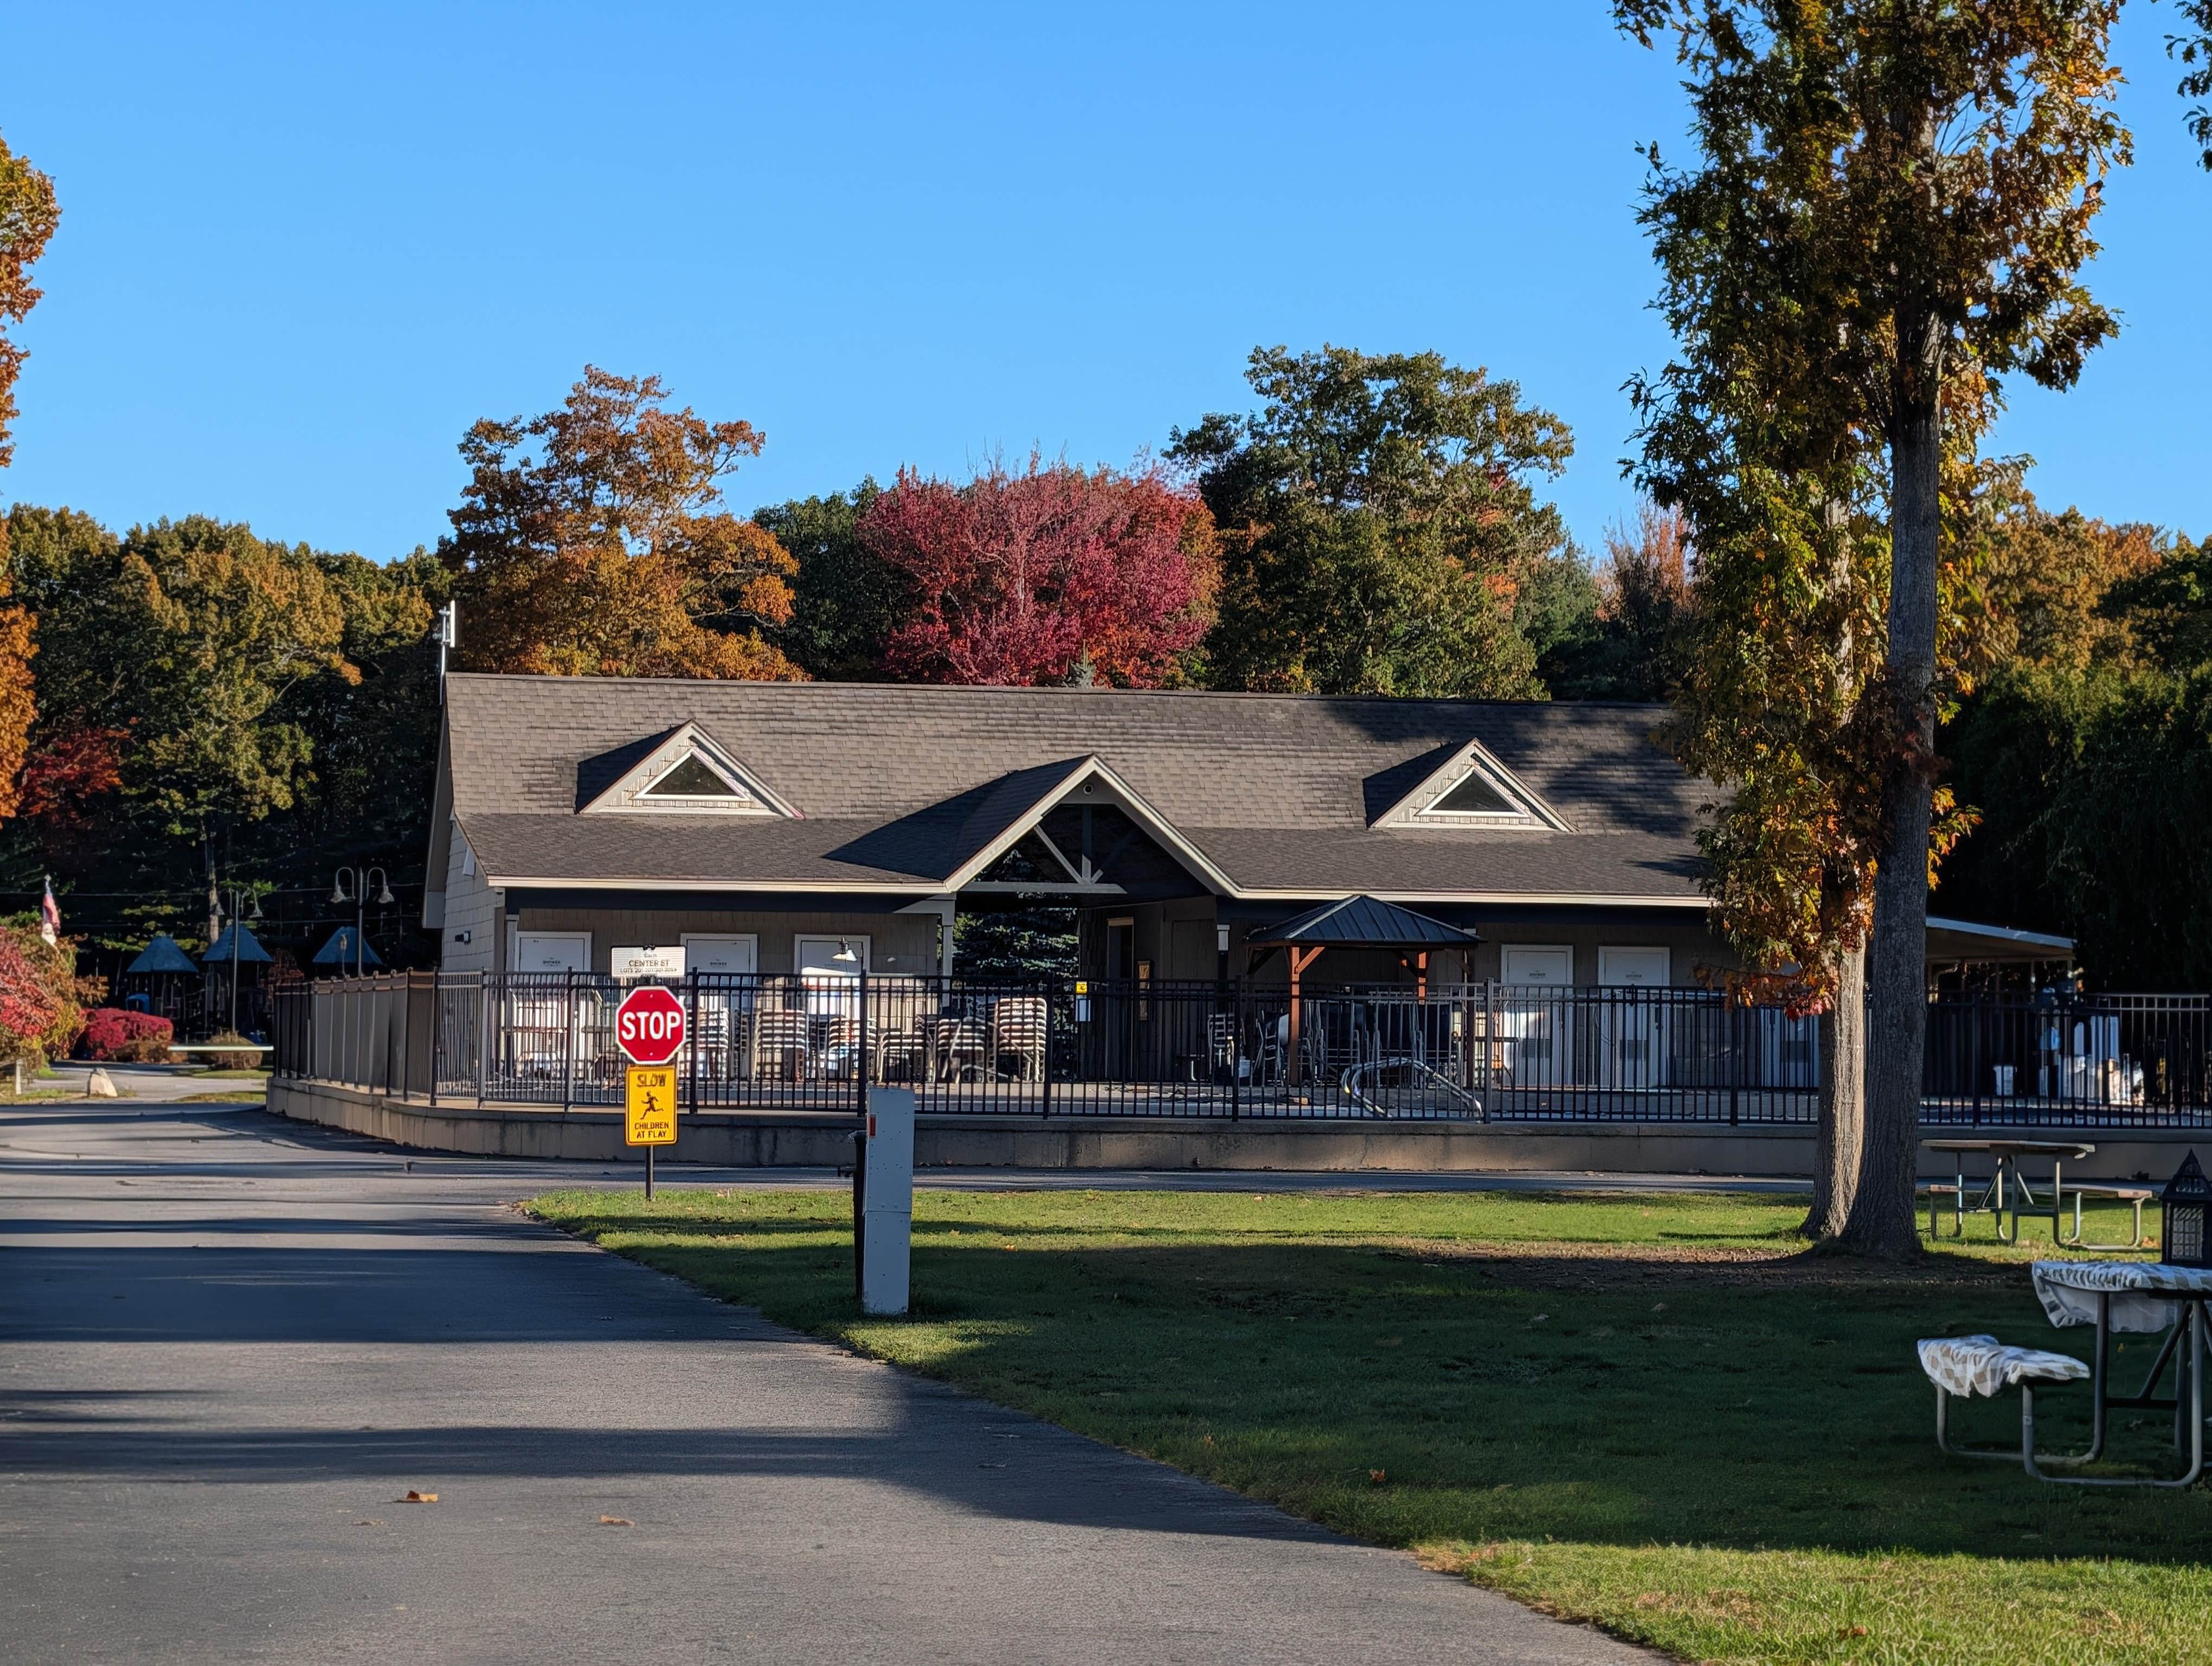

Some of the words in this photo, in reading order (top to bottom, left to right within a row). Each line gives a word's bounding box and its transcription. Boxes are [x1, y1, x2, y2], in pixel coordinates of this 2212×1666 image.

[628, 959, 659, 967] CENTER
[660, 958, 670, 966] ST
[621, 1010, 681, 1041] STOP
[636, 1073, 667, 1087] SLOW
[634, 1121, 670, 1130] CHILDREN
[636, 1130, 645, 1138] AT
[648, 1130, 667, 1138] PLAY
